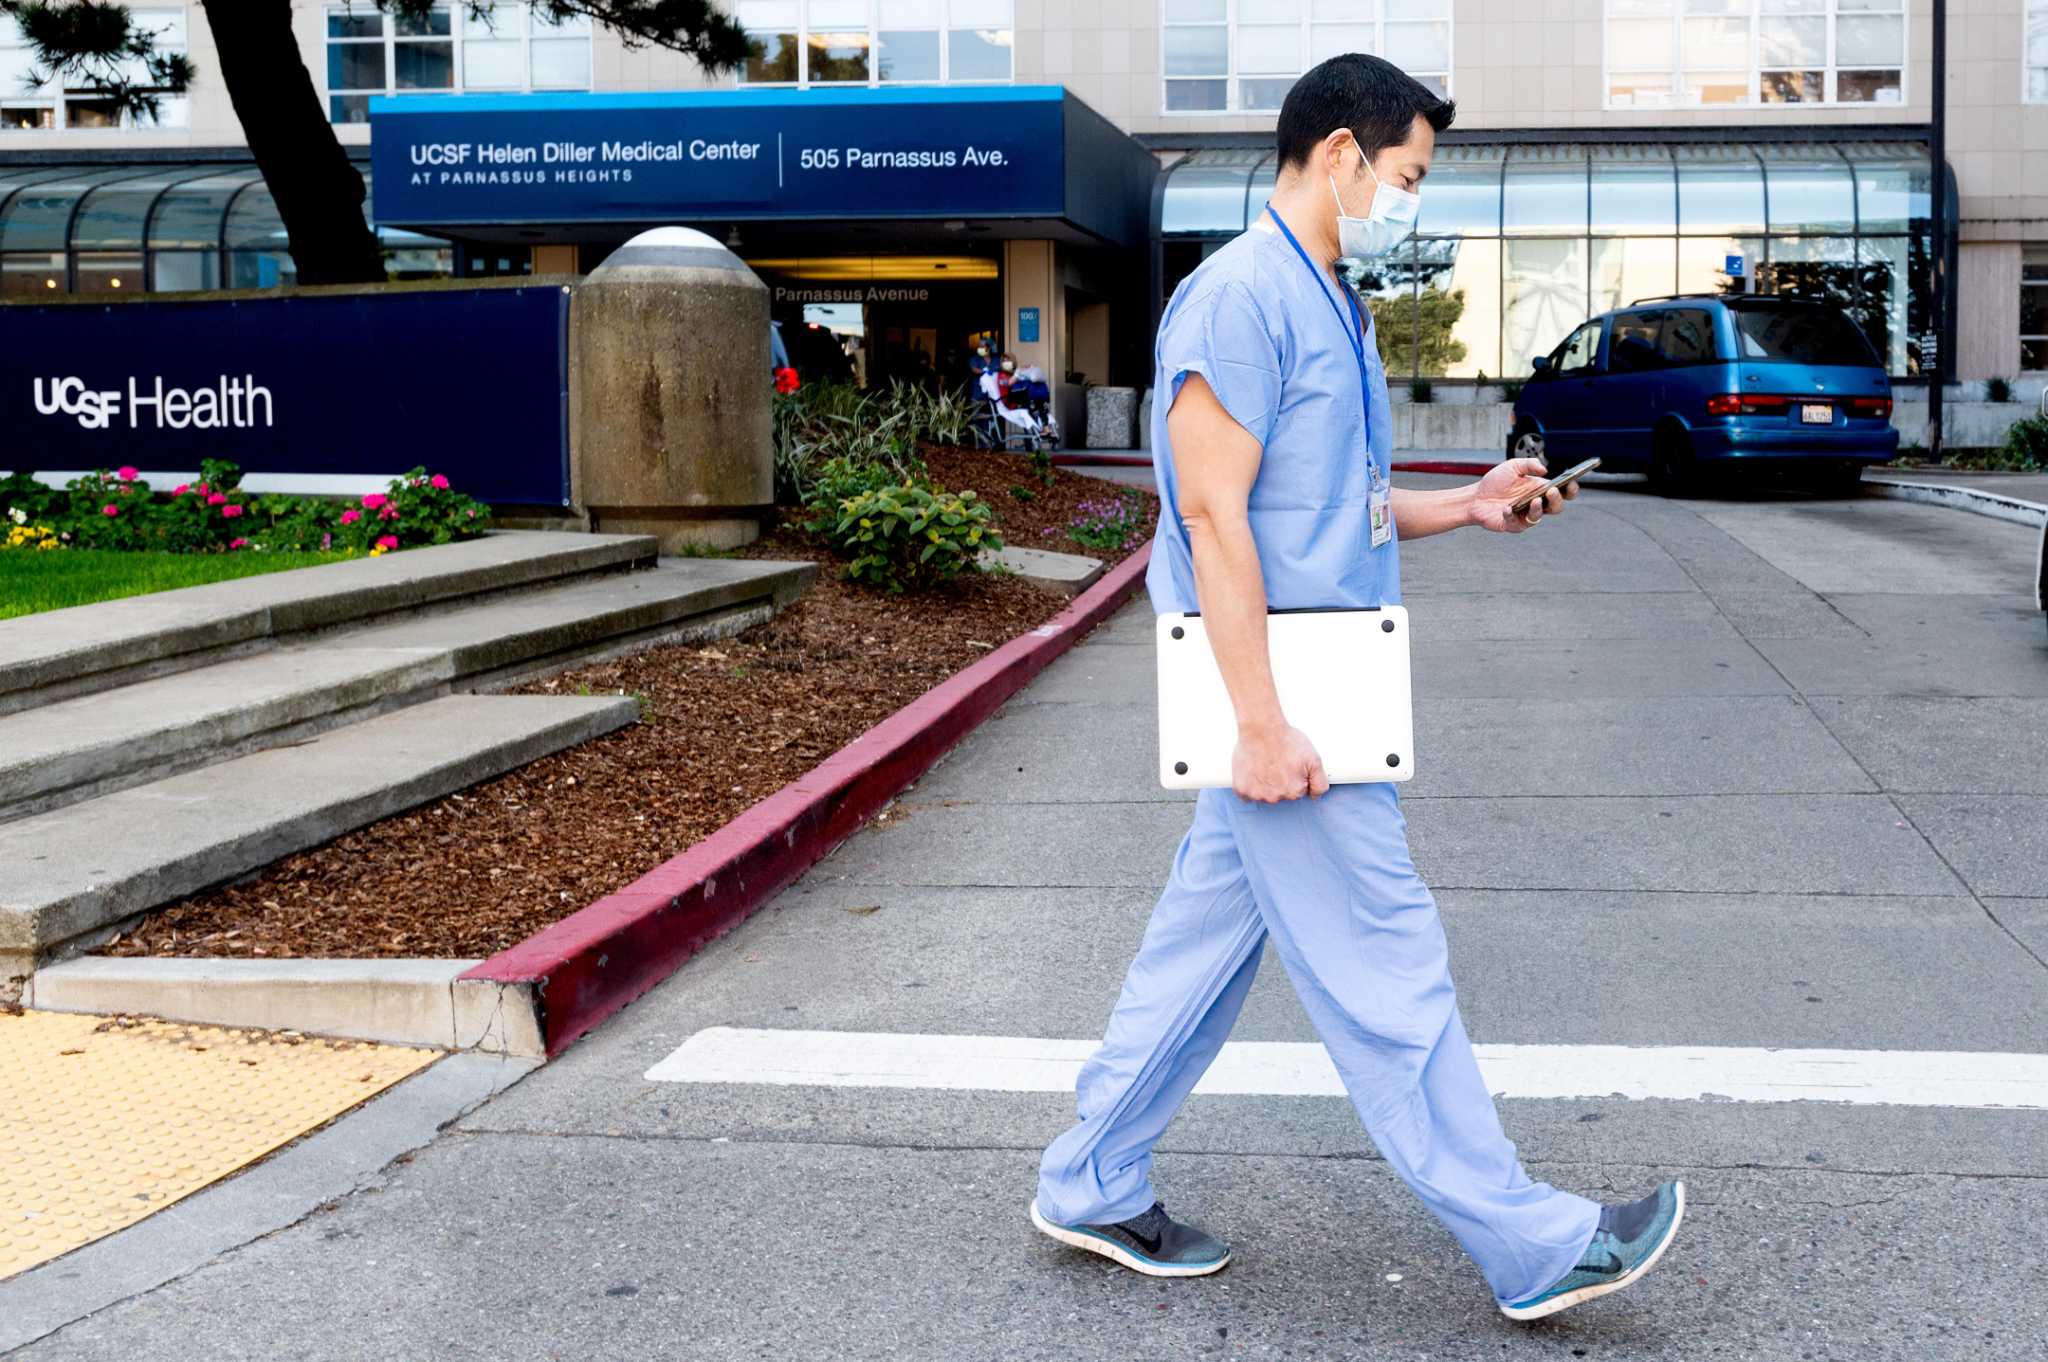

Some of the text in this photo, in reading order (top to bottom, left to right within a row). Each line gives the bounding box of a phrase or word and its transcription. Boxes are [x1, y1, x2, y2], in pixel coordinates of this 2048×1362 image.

[410, 139, 761, 165] UCSF Helen Diller Medical Center
[800, 146, 1009, 169] 505 Parnassus Ave.
[411, 168, 633, 185] AT PARNASSUS HEIGHTS
[775, 286, 929, 302] Parnassus Avenue
[33, 374, 273, 429] UCSF Health
